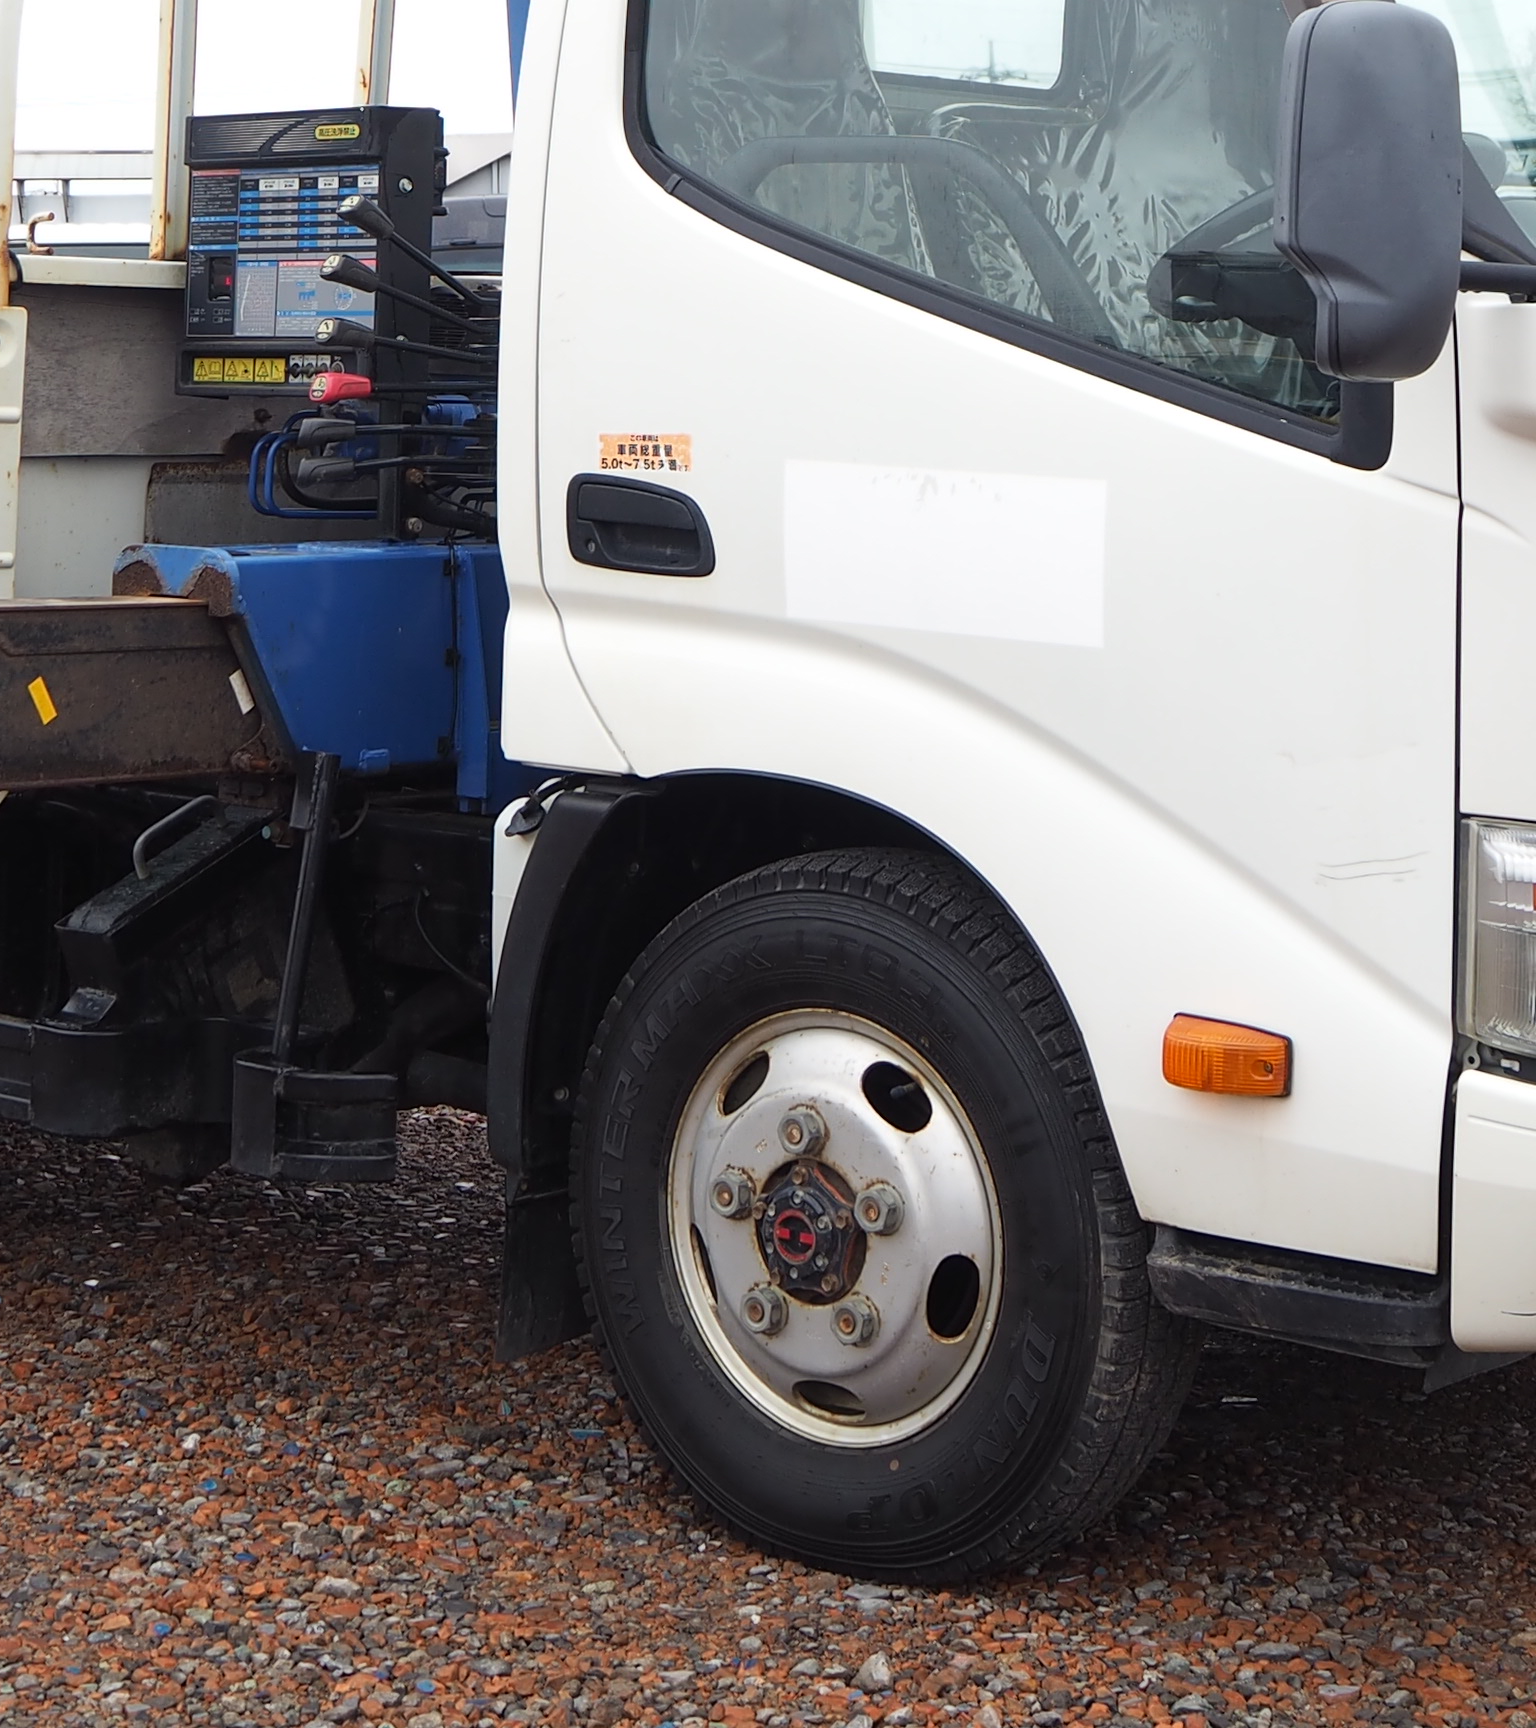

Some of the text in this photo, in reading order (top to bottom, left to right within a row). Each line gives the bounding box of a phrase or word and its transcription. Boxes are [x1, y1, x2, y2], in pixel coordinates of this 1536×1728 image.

[617, 444, 673, 457] 車両総重量
[599, 1069, 647, 1337] WINTER
[630, 931, 774, 1073] MAXX
